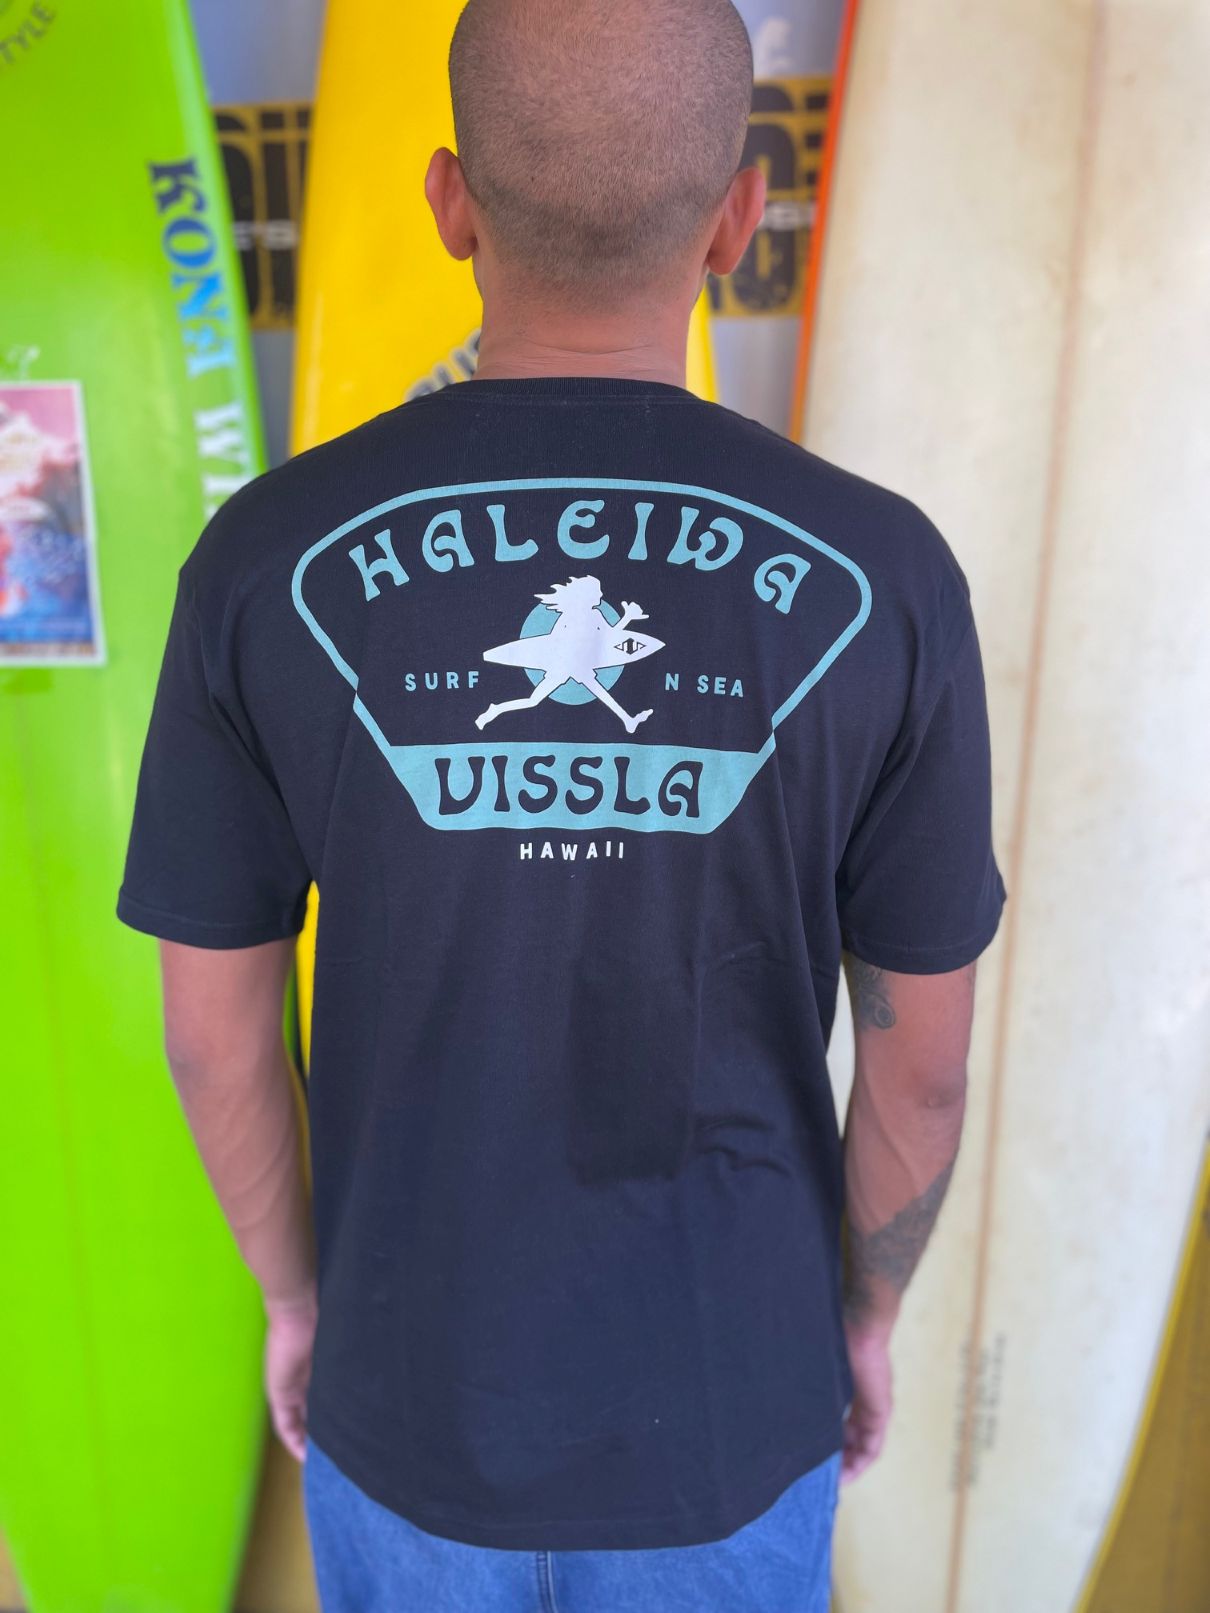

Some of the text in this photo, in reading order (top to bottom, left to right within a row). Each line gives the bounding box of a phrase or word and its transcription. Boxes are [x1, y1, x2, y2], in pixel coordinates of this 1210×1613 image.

[148, 157, 254, 520] KONA WI
[348, 499, 811, 615] HALEIWA
[404, 671, 744, 698] SURF N SEA
[519, 841, 625, 860] HAWAII
